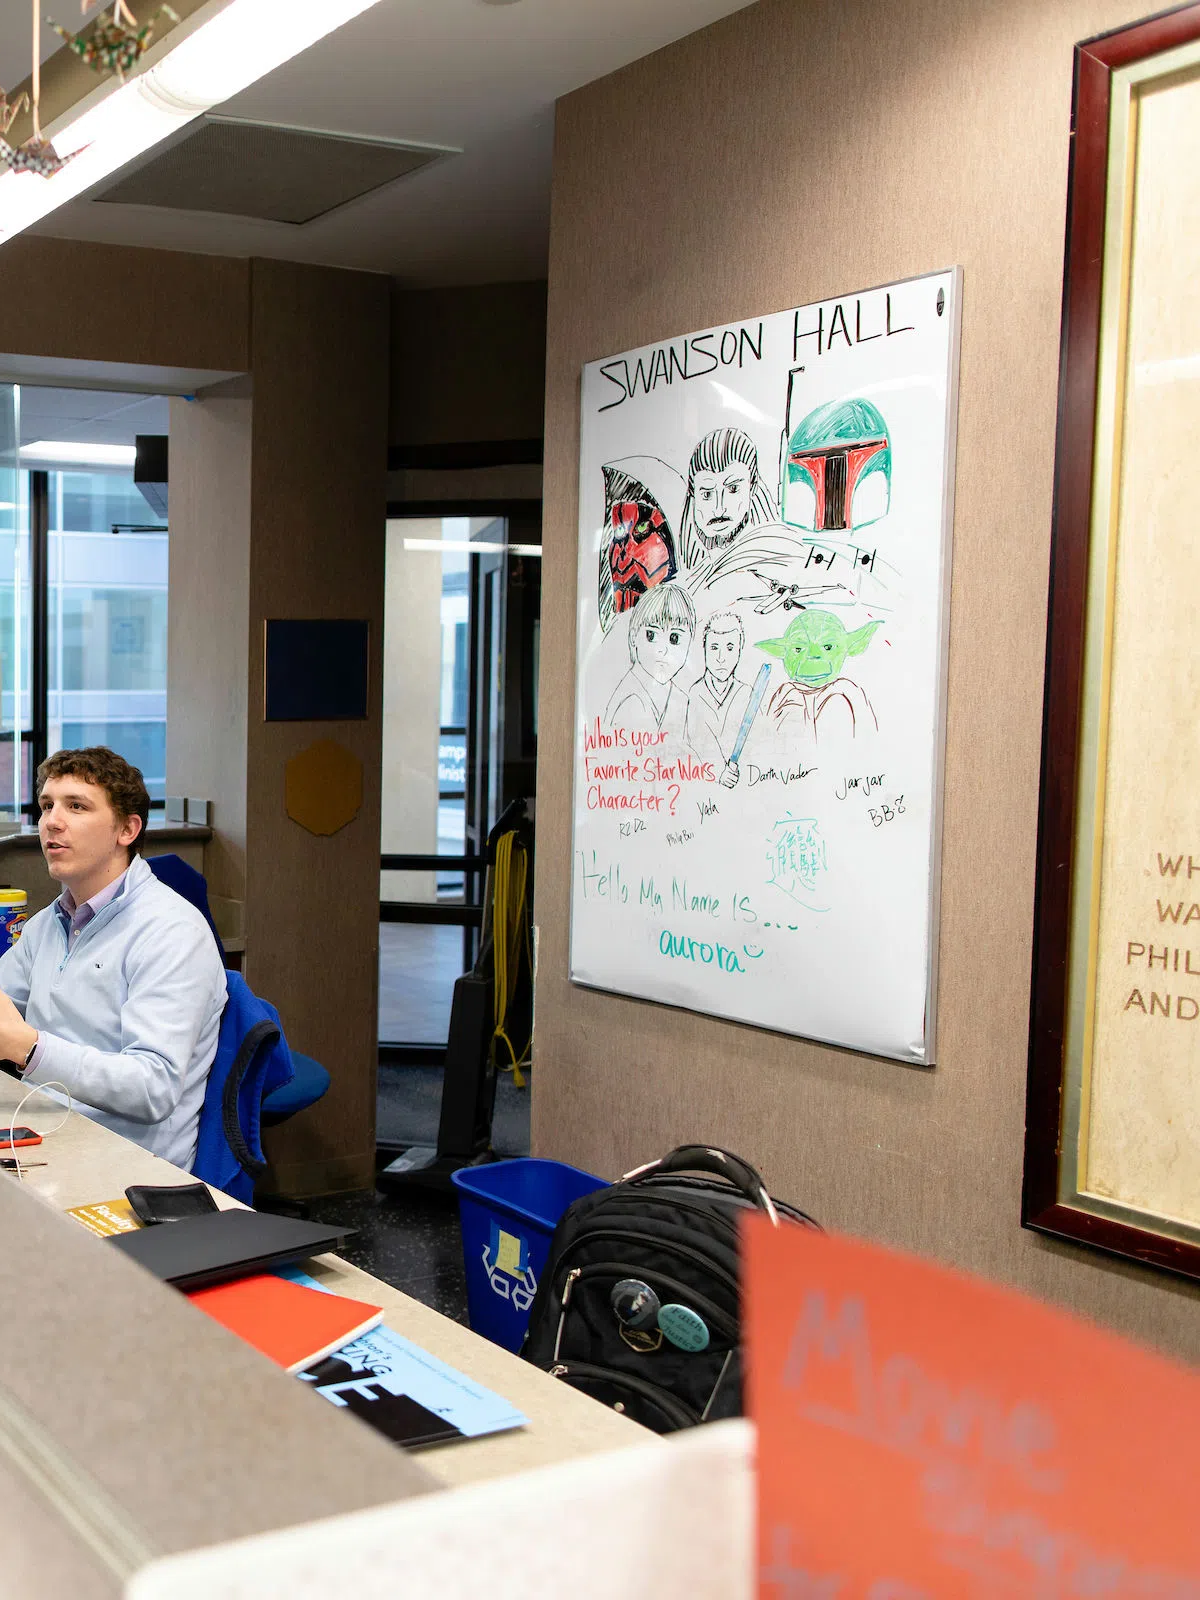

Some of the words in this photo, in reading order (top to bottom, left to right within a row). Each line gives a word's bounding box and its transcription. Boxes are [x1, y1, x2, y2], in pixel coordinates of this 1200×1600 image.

[598, 322, 763, 412] SWANSON
[793, 293, 915, 361] HALL
[584, 715, 612, 752] Who
[631, 730, 669, 756] your
[585, 756, 639, 782] Favorite
[643, 757, 676, 783] Star
[677, 754, 717, 782] Wars
[746, 764, 779, 787] Darth
[780, 763, 819, 785] Vader
[671, 874, 721, 918] Name
[659, 929, 747, 973] aurora
[1127, 941, 1200, 976] PHIL
[1124, 988, 1200, 1021] AND
